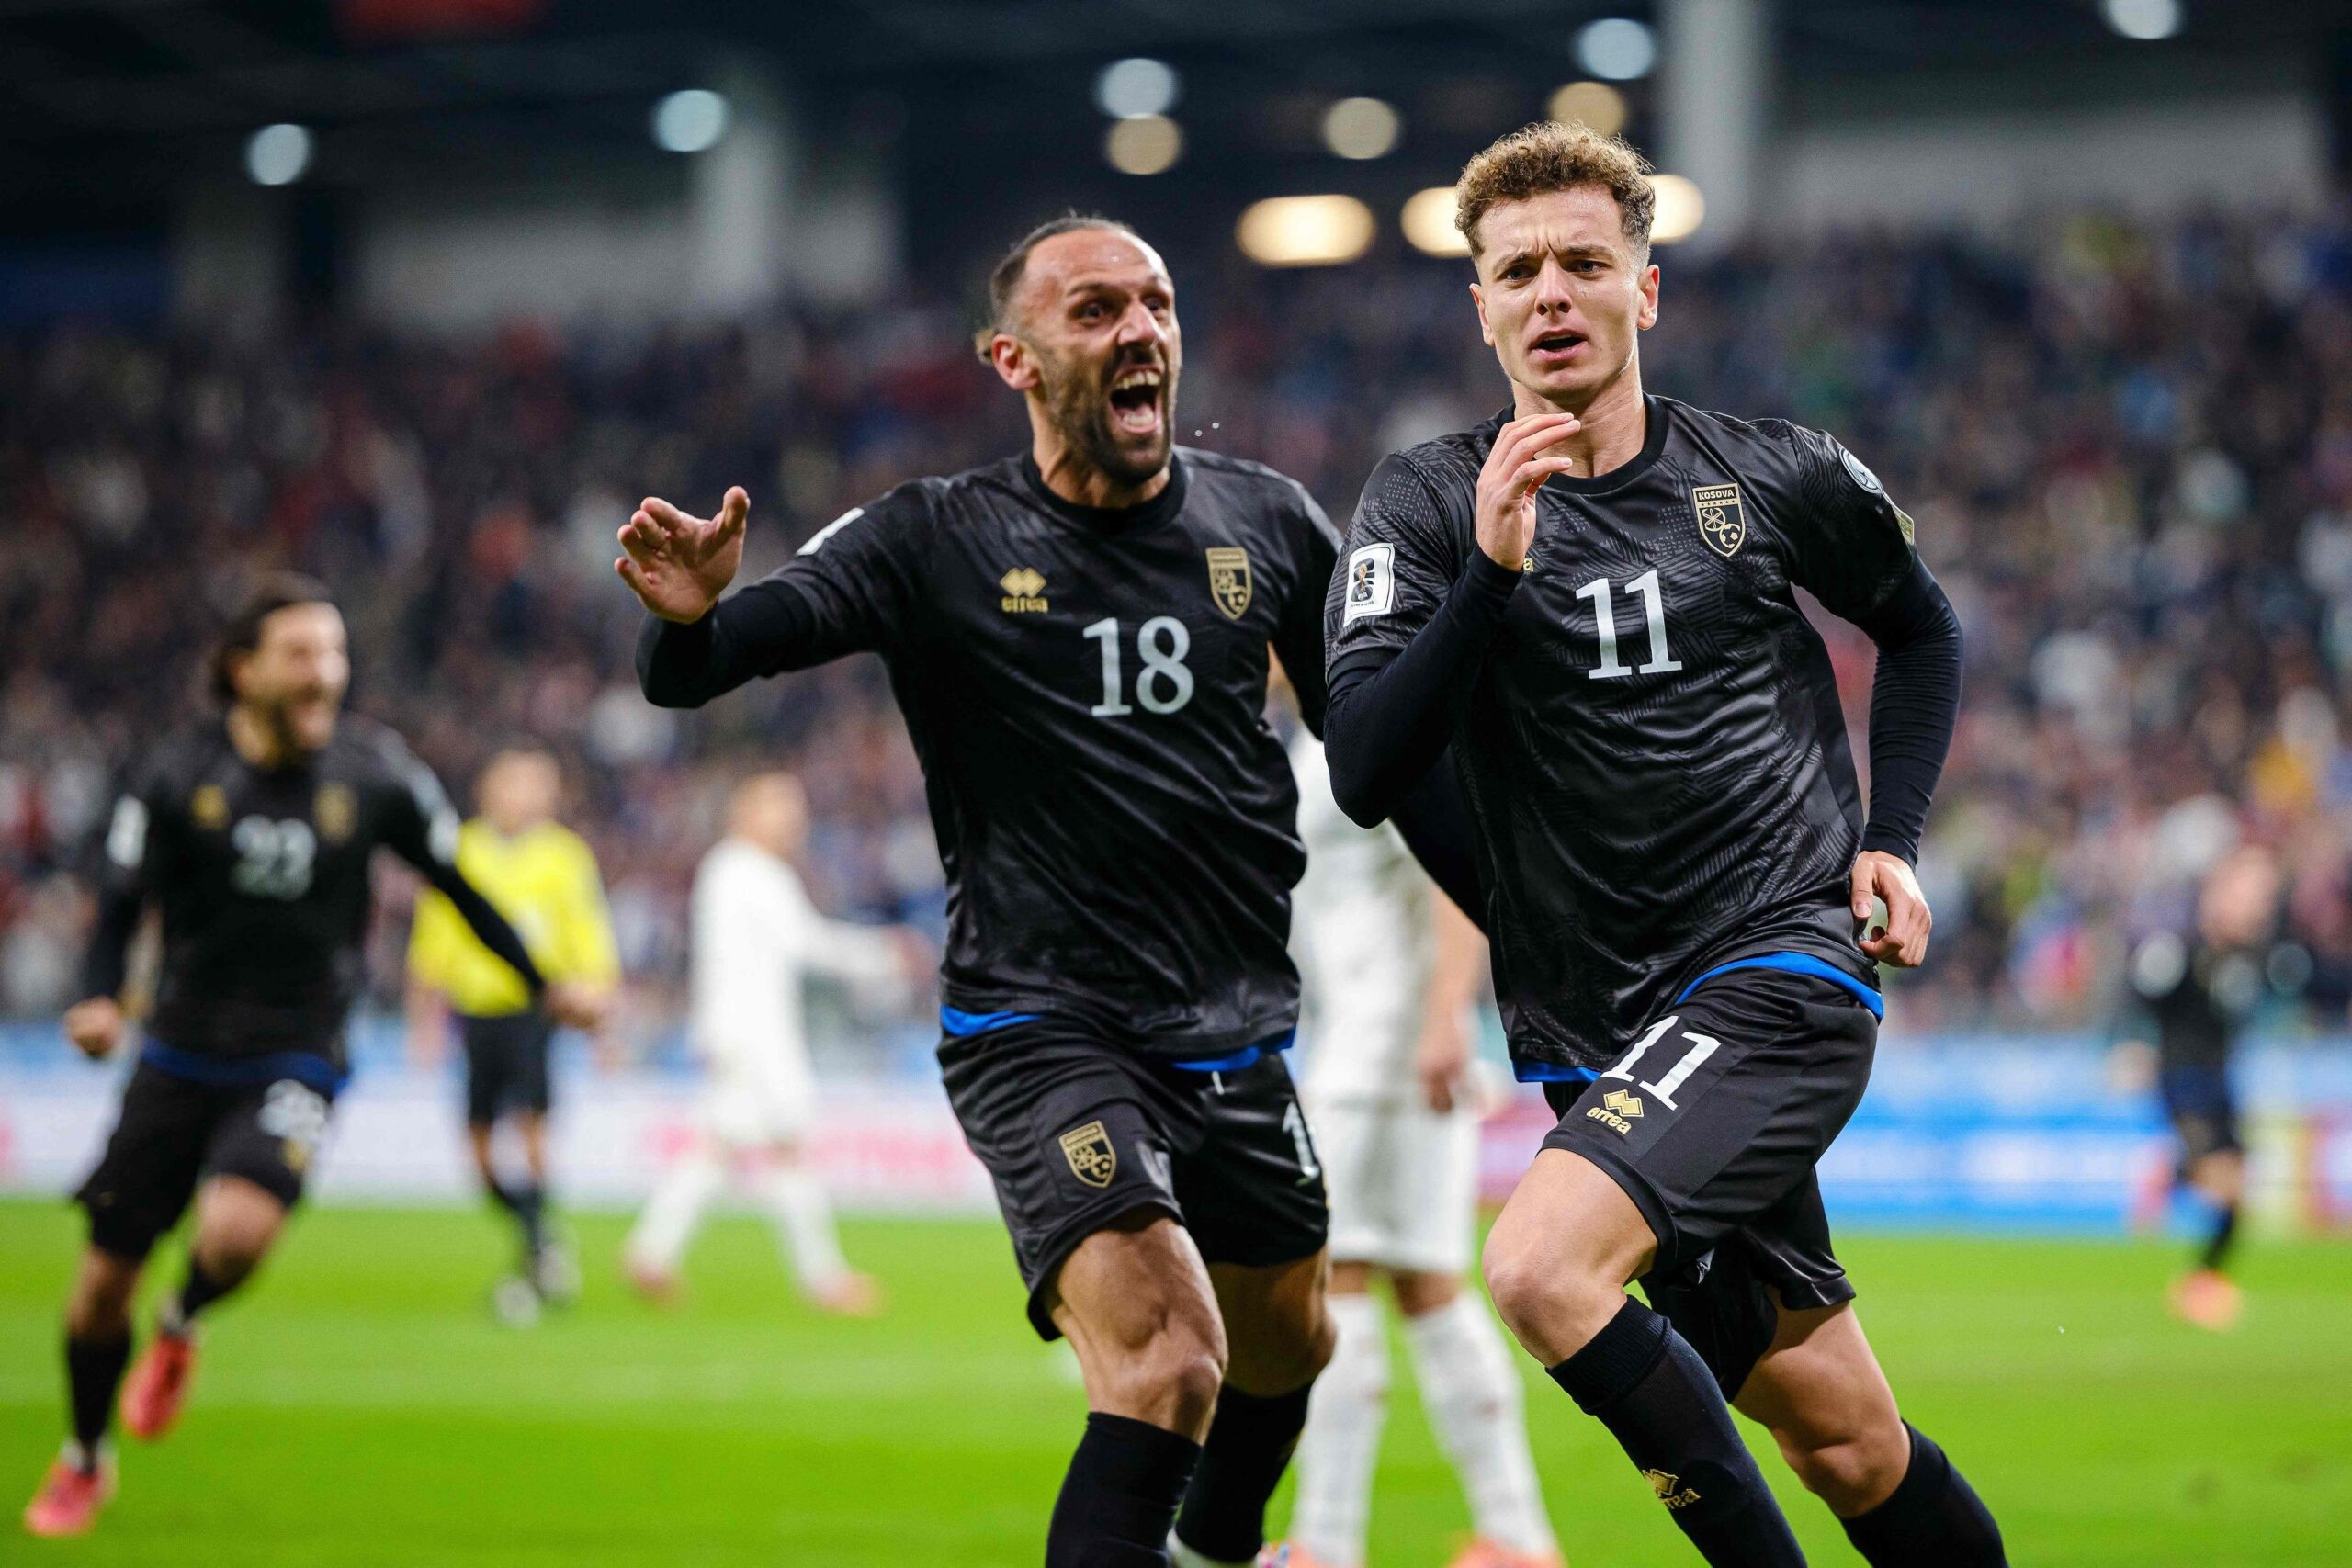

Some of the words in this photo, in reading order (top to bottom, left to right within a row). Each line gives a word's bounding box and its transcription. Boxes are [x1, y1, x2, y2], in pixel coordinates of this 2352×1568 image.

[1698, 489, 1735, 501] KOSOVA
[1082, 615, 1194, 717] 18
[1576, 570, 1682, 679] 11
[1600, 1015, 1721, 1111] 11
[1283, 1100, 1321, 1187] 1
[1586, 1106, 1632, 1135] errea
